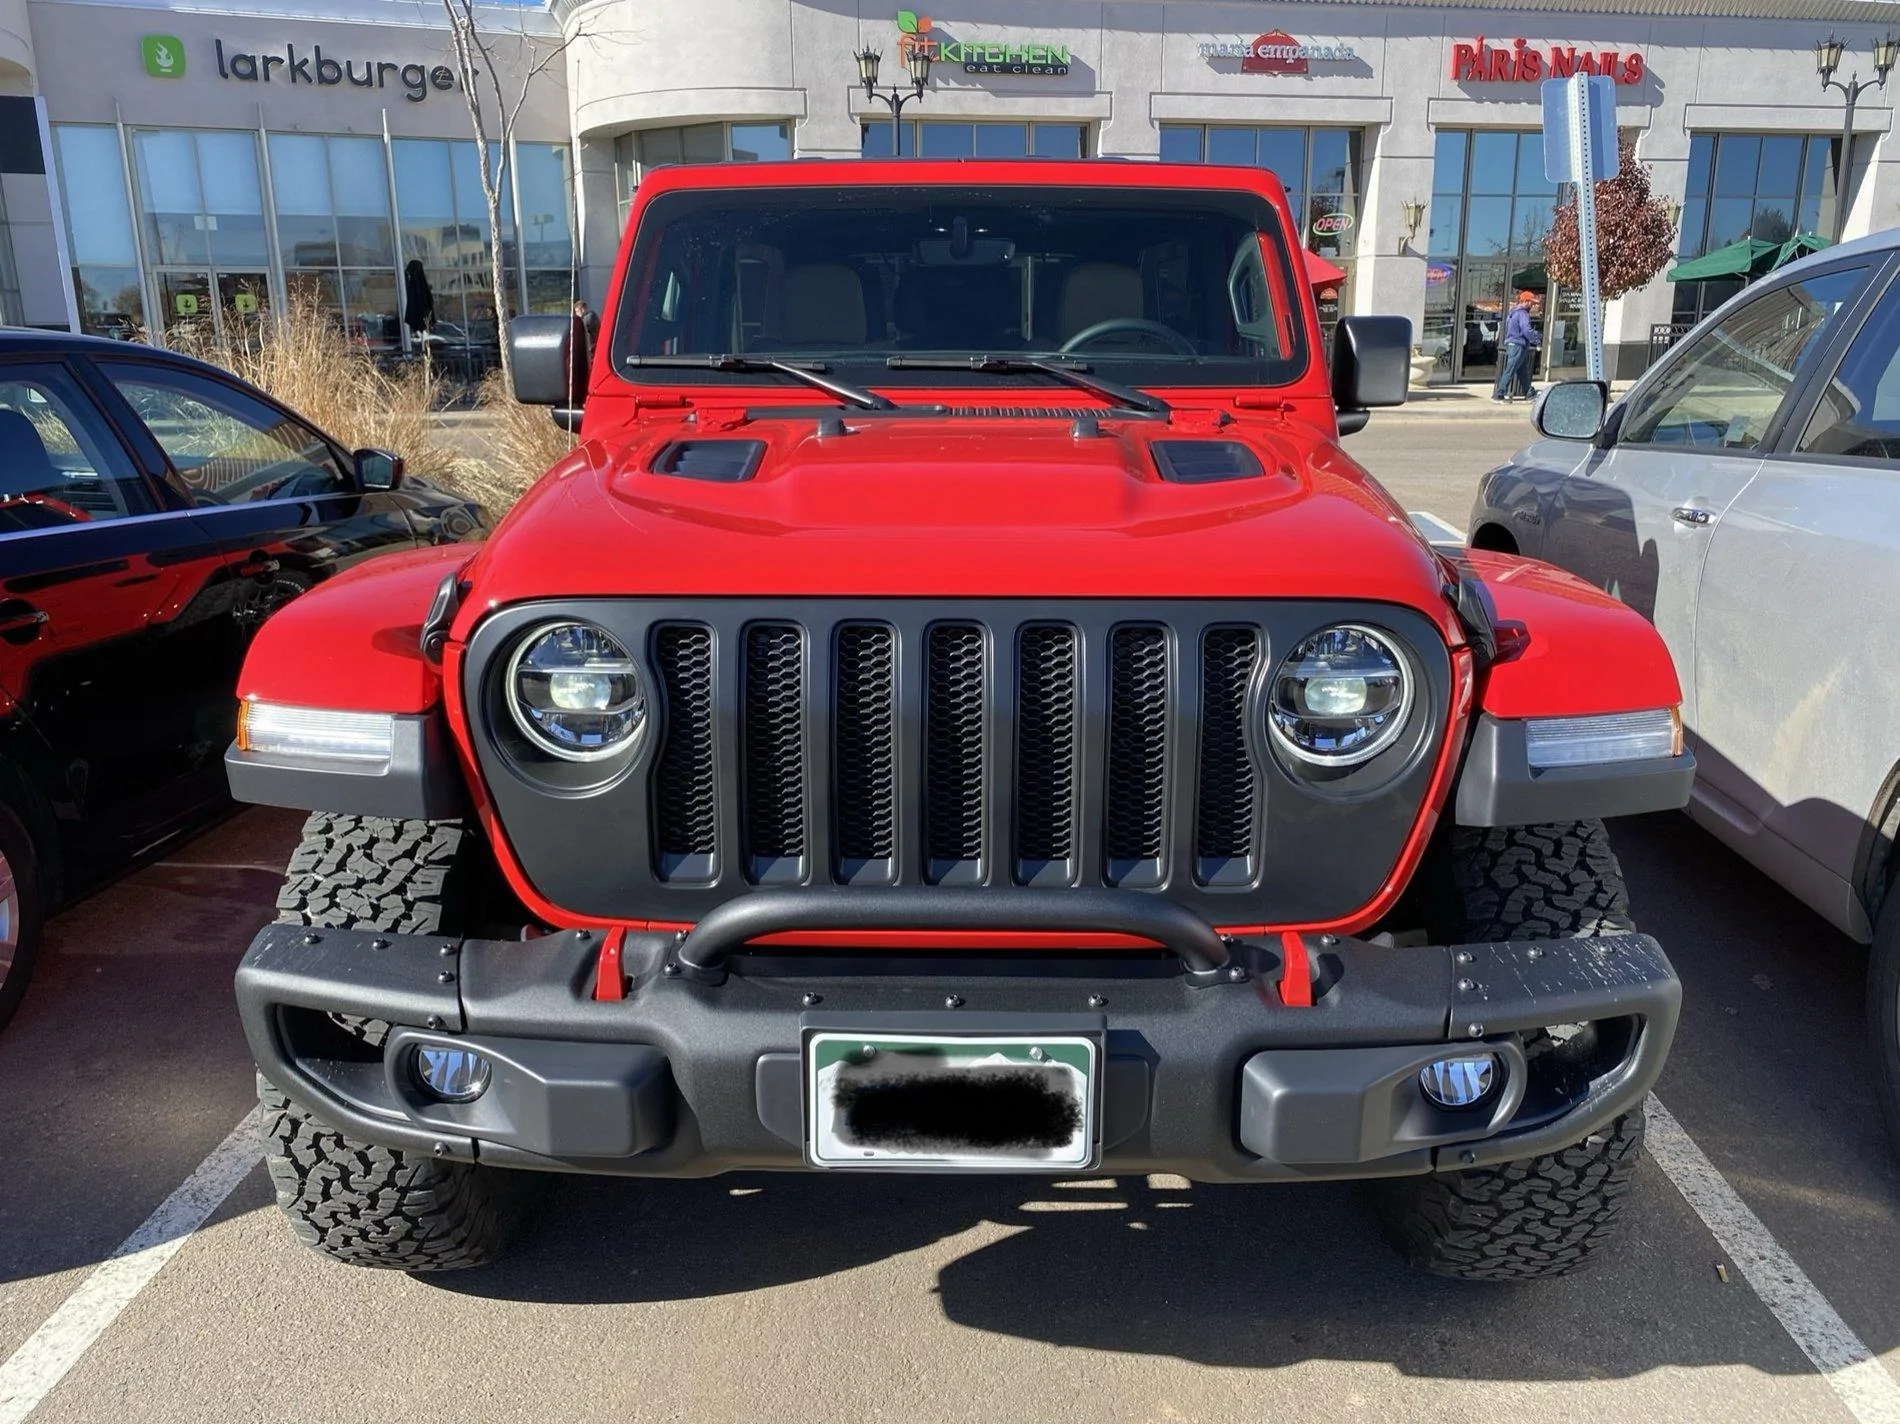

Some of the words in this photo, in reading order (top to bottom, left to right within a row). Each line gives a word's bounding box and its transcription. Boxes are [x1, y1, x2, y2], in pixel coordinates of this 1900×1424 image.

[1257, 42, 1357, 64] empanada
[966, 64, 1001, 73] eat
[1012, 64, 1068, 74] clean
[1550, 46, 1644, 85] NAILS
[1315, 217, 1350, 231] OPEN
